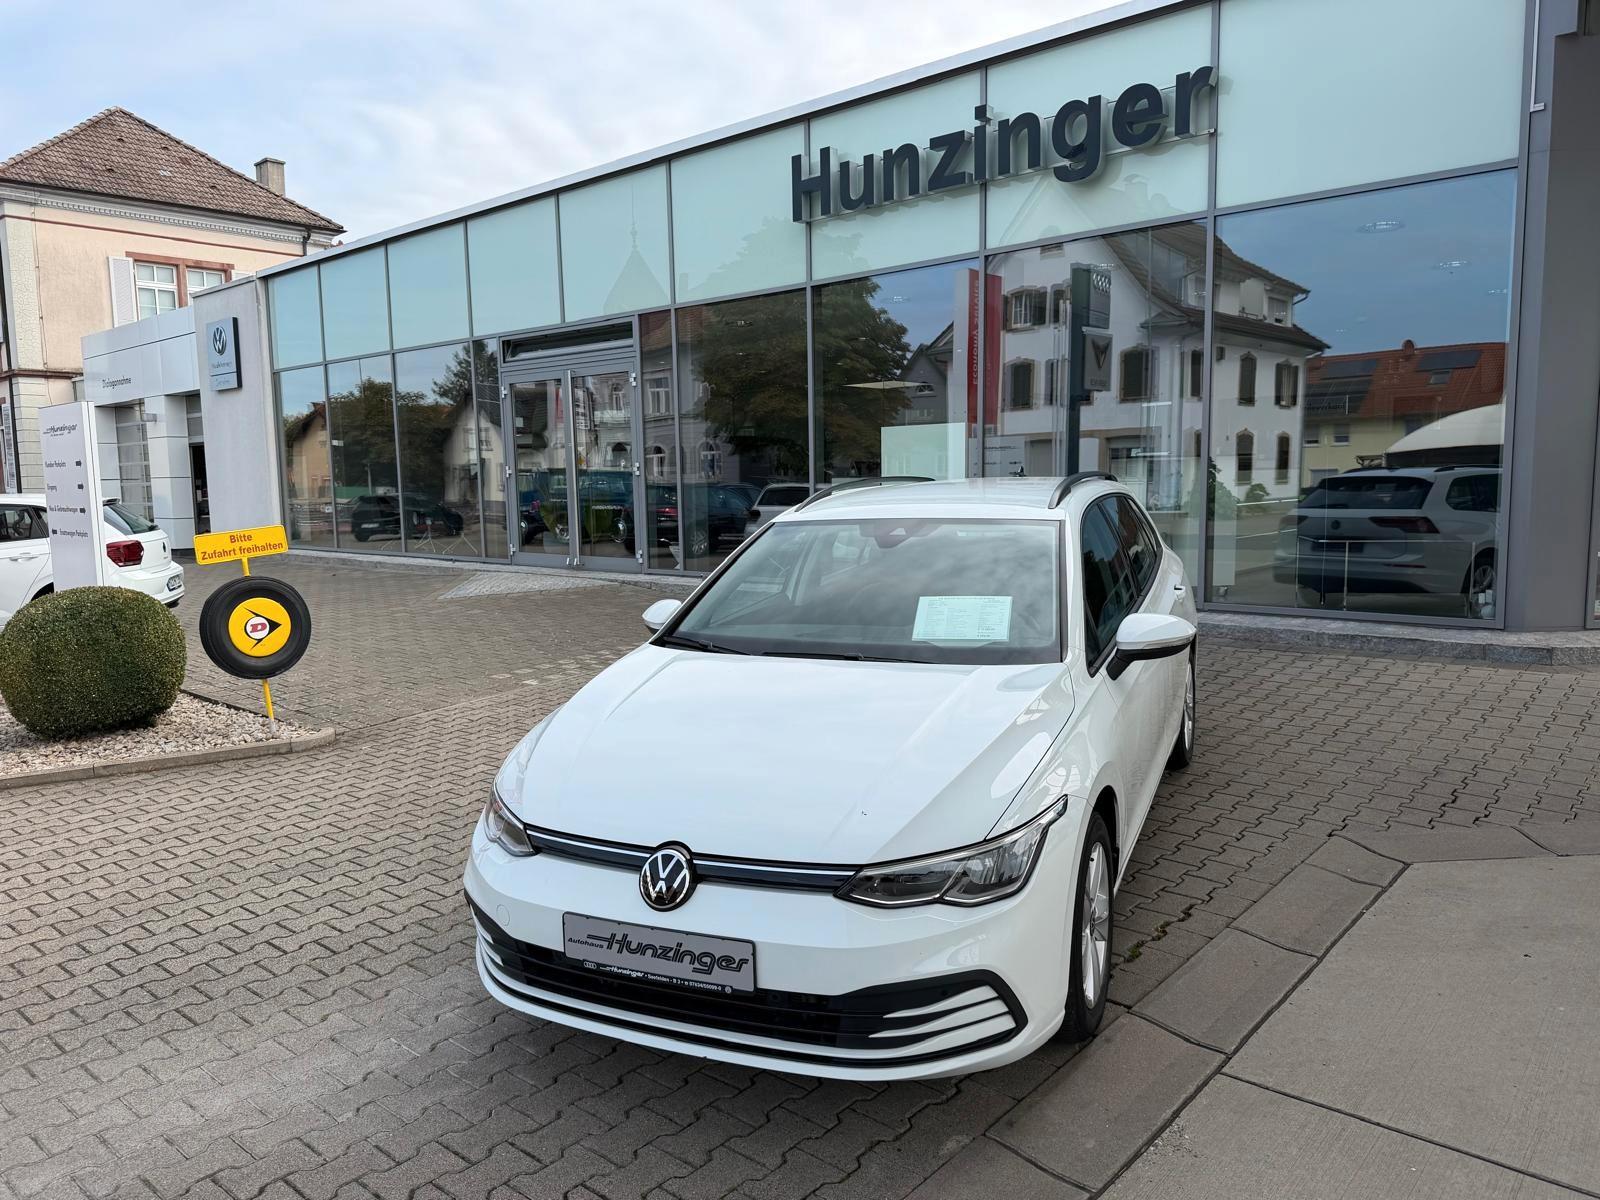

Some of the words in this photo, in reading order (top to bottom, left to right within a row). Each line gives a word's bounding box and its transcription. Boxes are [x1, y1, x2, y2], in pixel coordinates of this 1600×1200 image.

[791, 65, 1219, 223] Hunzinger
[230, 534, 252, 543] Bitte
[201, 548, 236, 560] Zufahrt
[239, 543, 283, 554] freihalten
[250, 622, 267, 633] D
[568, 938, 604, 949] Autohaus
[587, 932, 749, 975] Hunzinger
